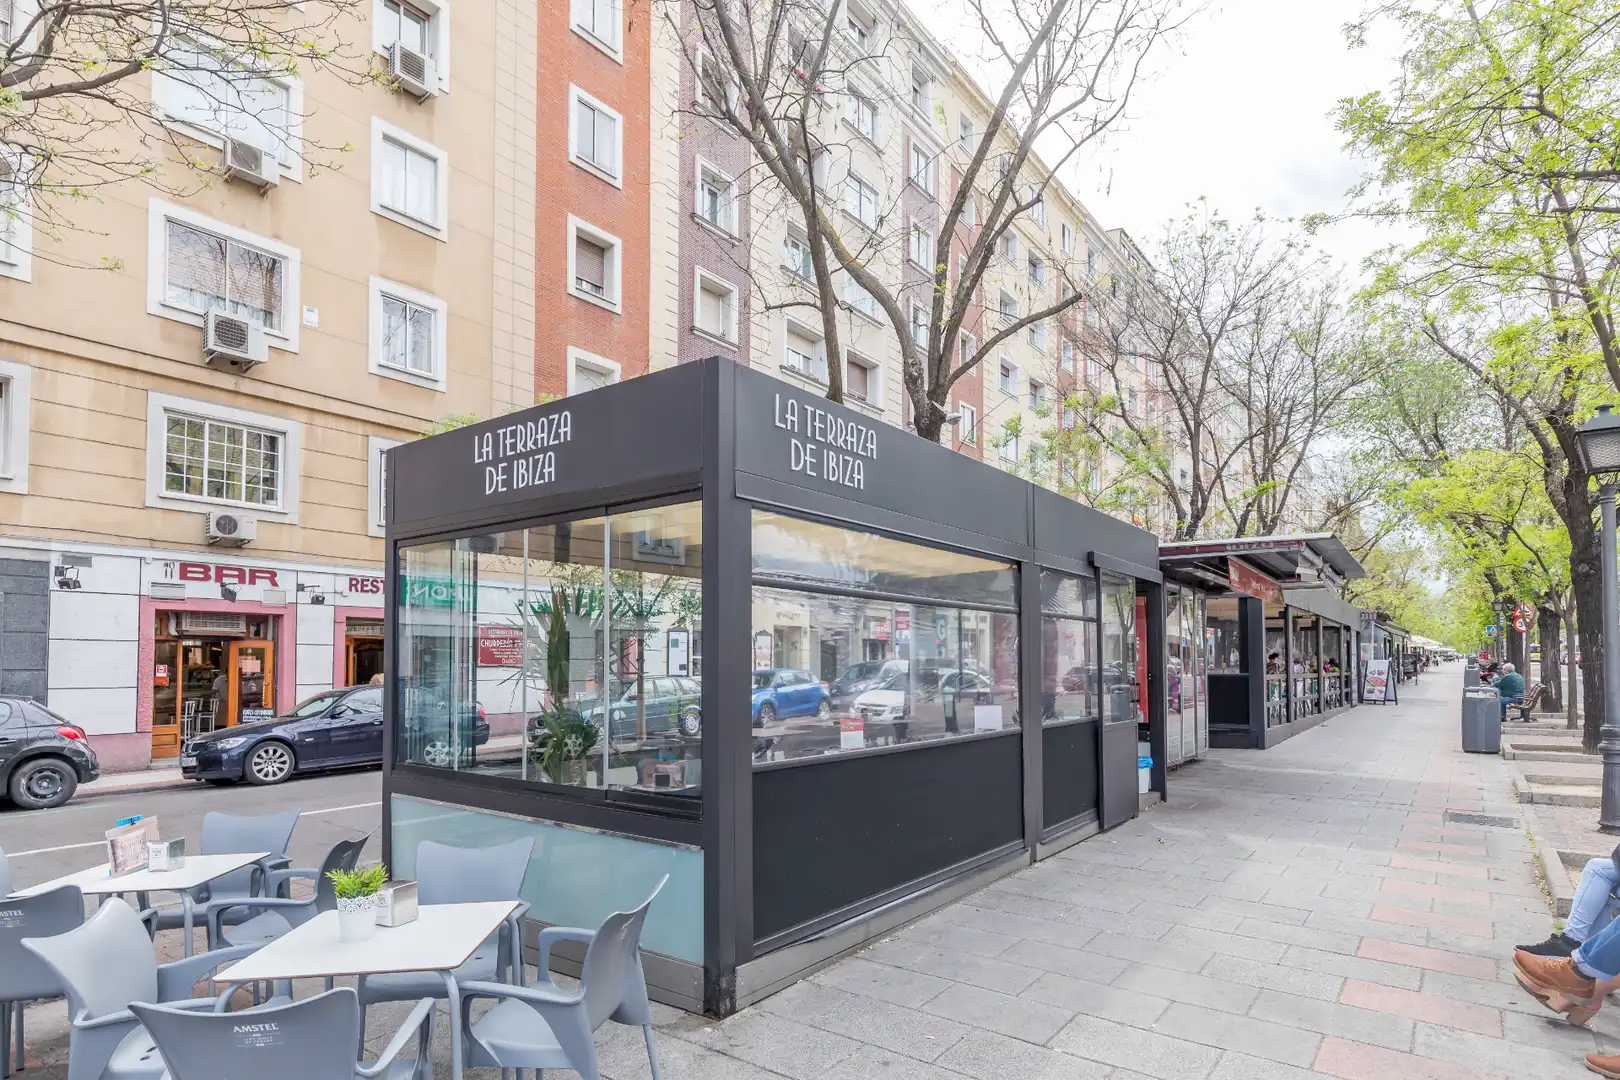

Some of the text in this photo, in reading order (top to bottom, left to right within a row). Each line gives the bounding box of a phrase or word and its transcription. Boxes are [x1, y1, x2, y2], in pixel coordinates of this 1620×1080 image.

[474, 411, 571, 463] LA TERRAZA
[775, 393, 877, 459] LA TERRAZA
[485, 451, 555, 495] DE IBIZA
[791, 438, 864, 490] DE IBIZA
[179, 562, 279, 587] BAR
[233, 1022, 279, 1033] AMSTEL
